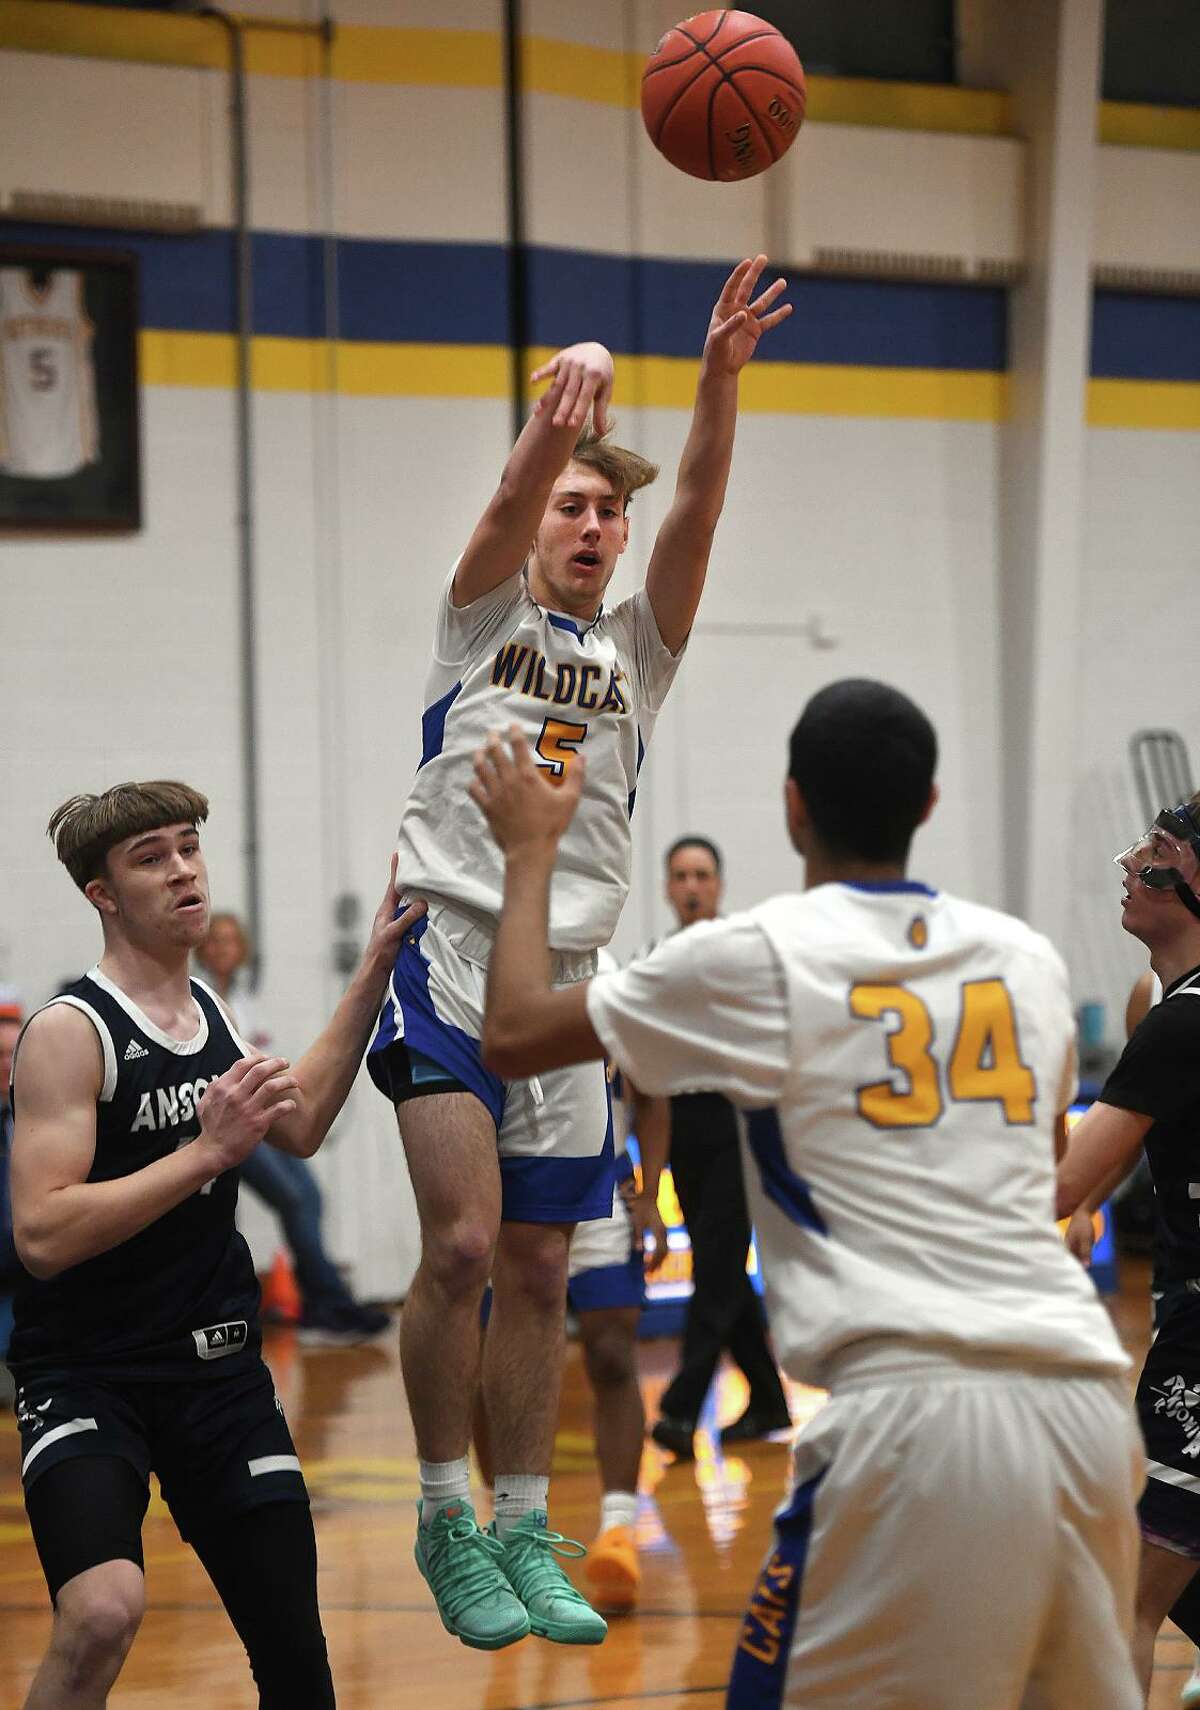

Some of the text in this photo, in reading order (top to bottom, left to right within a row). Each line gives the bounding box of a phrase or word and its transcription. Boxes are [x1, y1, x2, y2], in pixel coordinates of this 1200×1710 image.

[29, 347, 58, 393] 5
[535, 716, 588, 787] 5
[124, 1048, 150, 1061] adidas
[848, 977, 1038, 1130] 34
